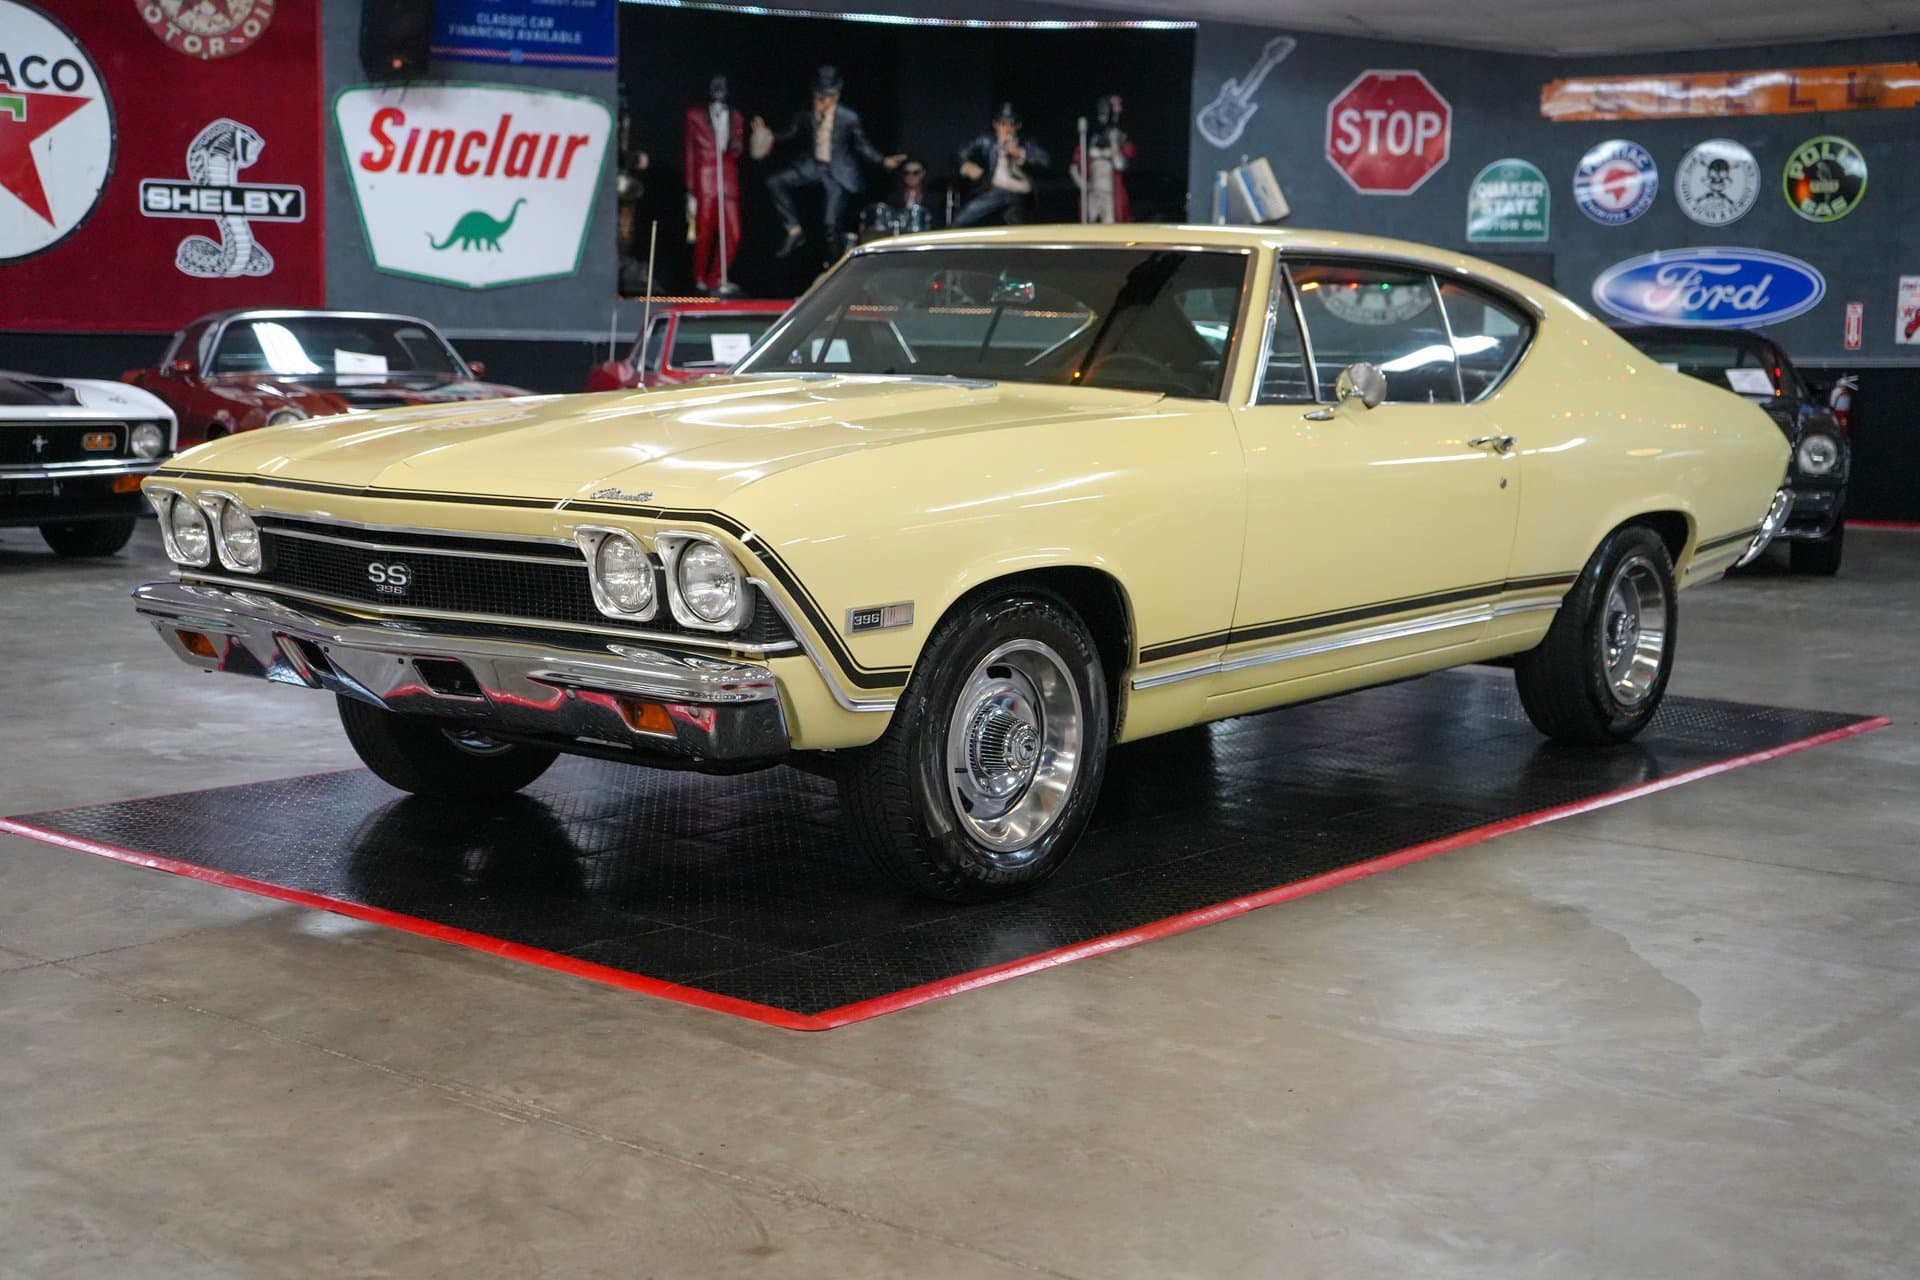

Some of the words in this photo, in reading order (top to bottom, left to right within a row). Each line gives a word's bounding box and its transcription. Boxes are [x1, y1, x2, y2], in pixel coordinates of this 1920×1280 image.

[144, 0, 272, 55] OTOR-OI
[476, 12, 527, 27] CLASSIC
[529, 16, 555, 28] CAR
[449, 24, 514, 40] FINANCING
[517, 30, 582, 44] AVAILABLE
[1338, 109, 1442, 155] STOP
[361, 107, 590, 180] Sinclair
[1580, 142, 1651, 176] PTIAC
[1476, 181, 1544, 198] QUAKER
[147, 187, 295, 213] SHELBY
[1482, 199, 1538, 215] STATE
[1801, 197, 1847, 216] GAS
[1472, 219, 1519, 231] TOR
[1522, 219, 1544, 231] OIL
[1643, 262, 1773, 312] Ford
[368, 562, 407, 586] SS
[375, 583, 403, 595] 396
[853, 613, 880, 625] 396
